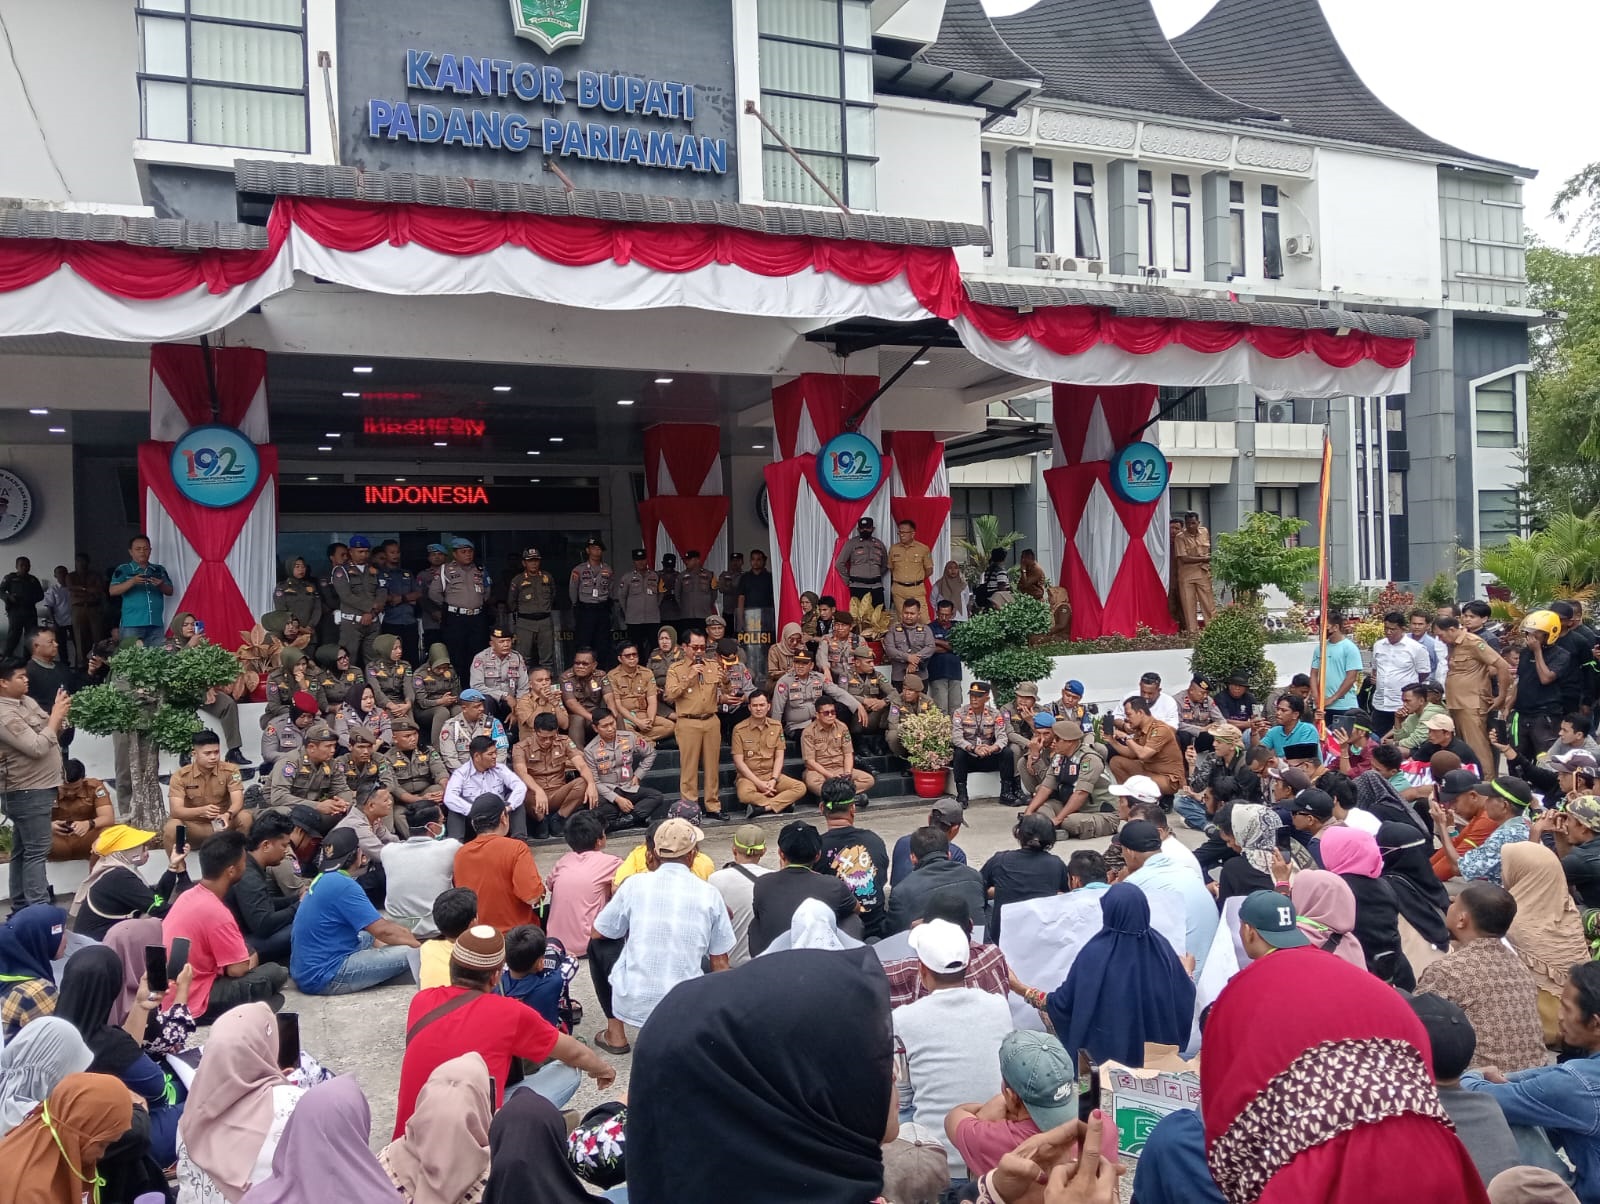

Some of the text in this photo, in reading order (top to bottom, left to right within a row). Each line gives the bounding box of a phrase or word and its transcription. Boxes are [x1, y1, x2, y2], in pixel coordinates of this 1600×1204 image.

[406, 48, 695, 121] KANTOR BUPATI
[369, 99, 727, 174] PADANG PARIAMAN
[182, 447, 246, 477] 192
[829, 450, 872, 474] 192
[1125, 459, 1160, 481] 192
[365, 485, 489, 504] INDONESIA
[737, 632, 771, 644] POLISI
[1276, 906, 1292, 927] H
